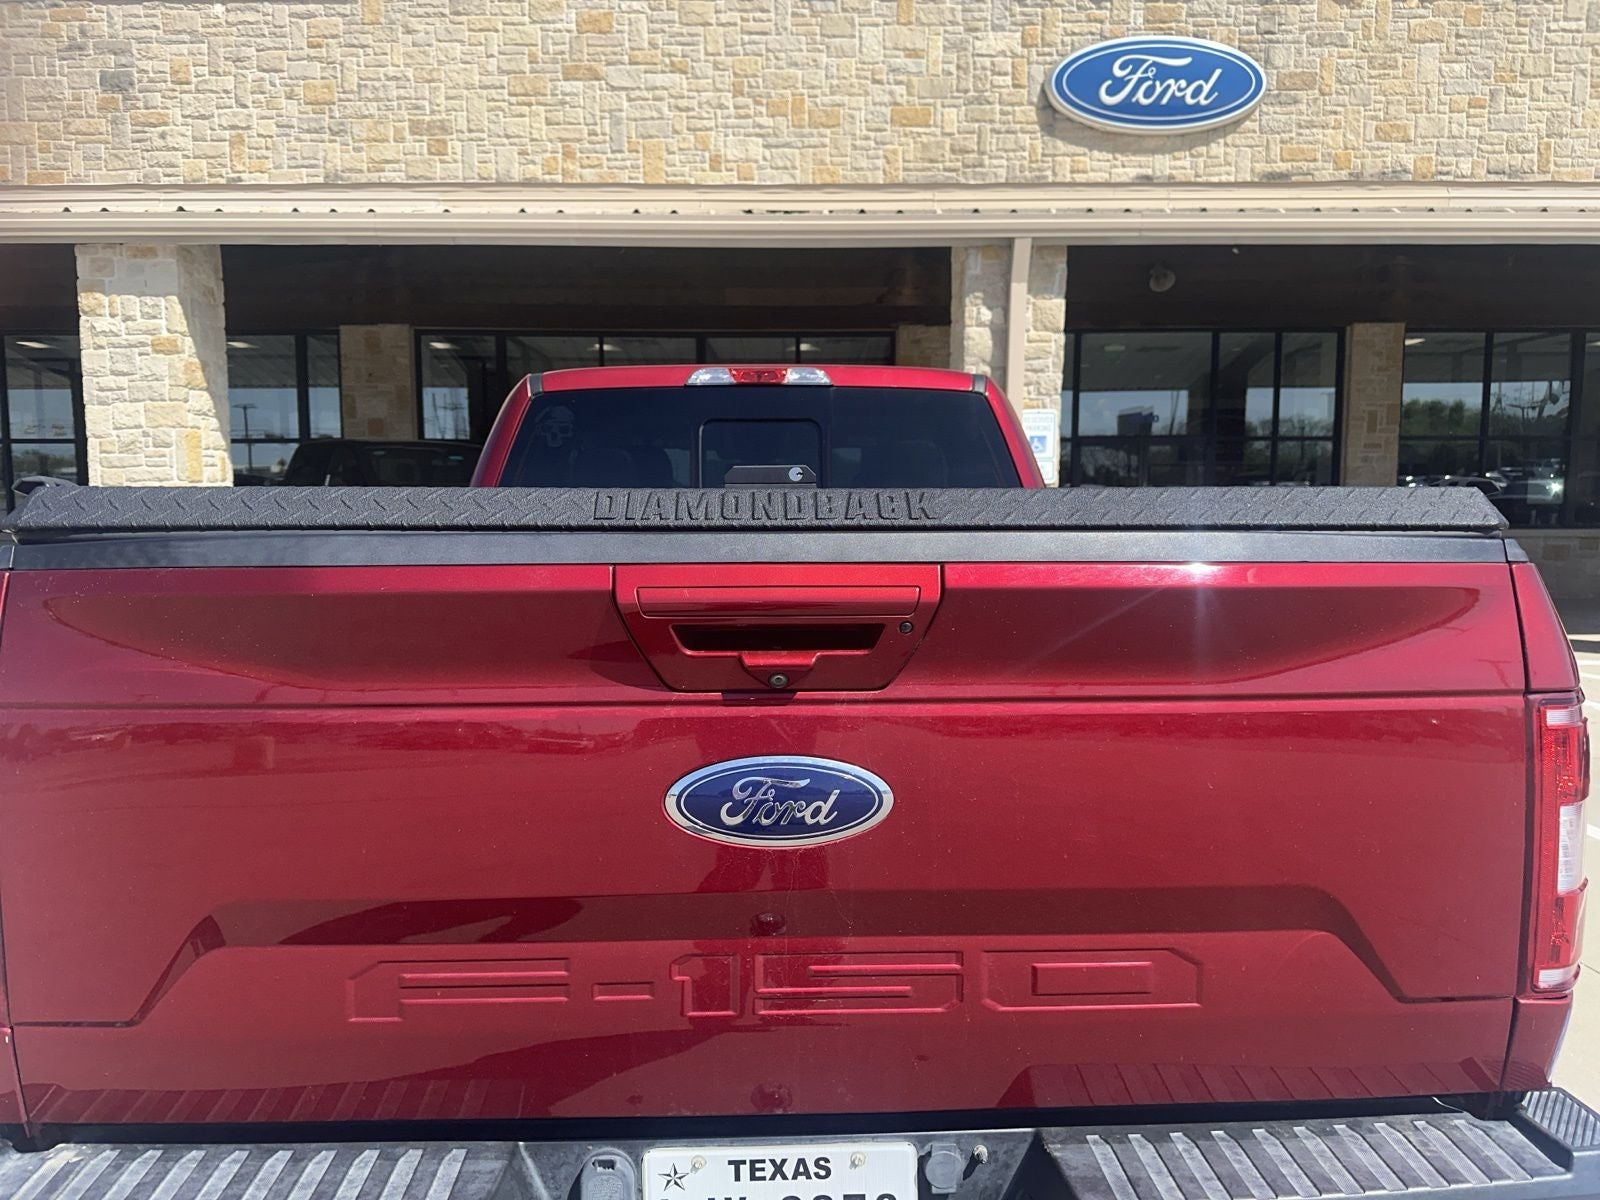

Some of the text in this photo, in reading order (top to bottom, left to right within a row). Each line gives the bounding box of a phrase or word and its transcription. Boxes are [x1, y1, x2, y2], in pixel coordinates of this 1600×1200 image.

[1098, 54, 1223, 106] Ford
[592, 489, 938, 522] DIAMONDBACK
[720, 776, 841, 826] Ford
[346, 949, 1202, 1022] F-150
[727, 1156, 832, 1182] TEXAS
